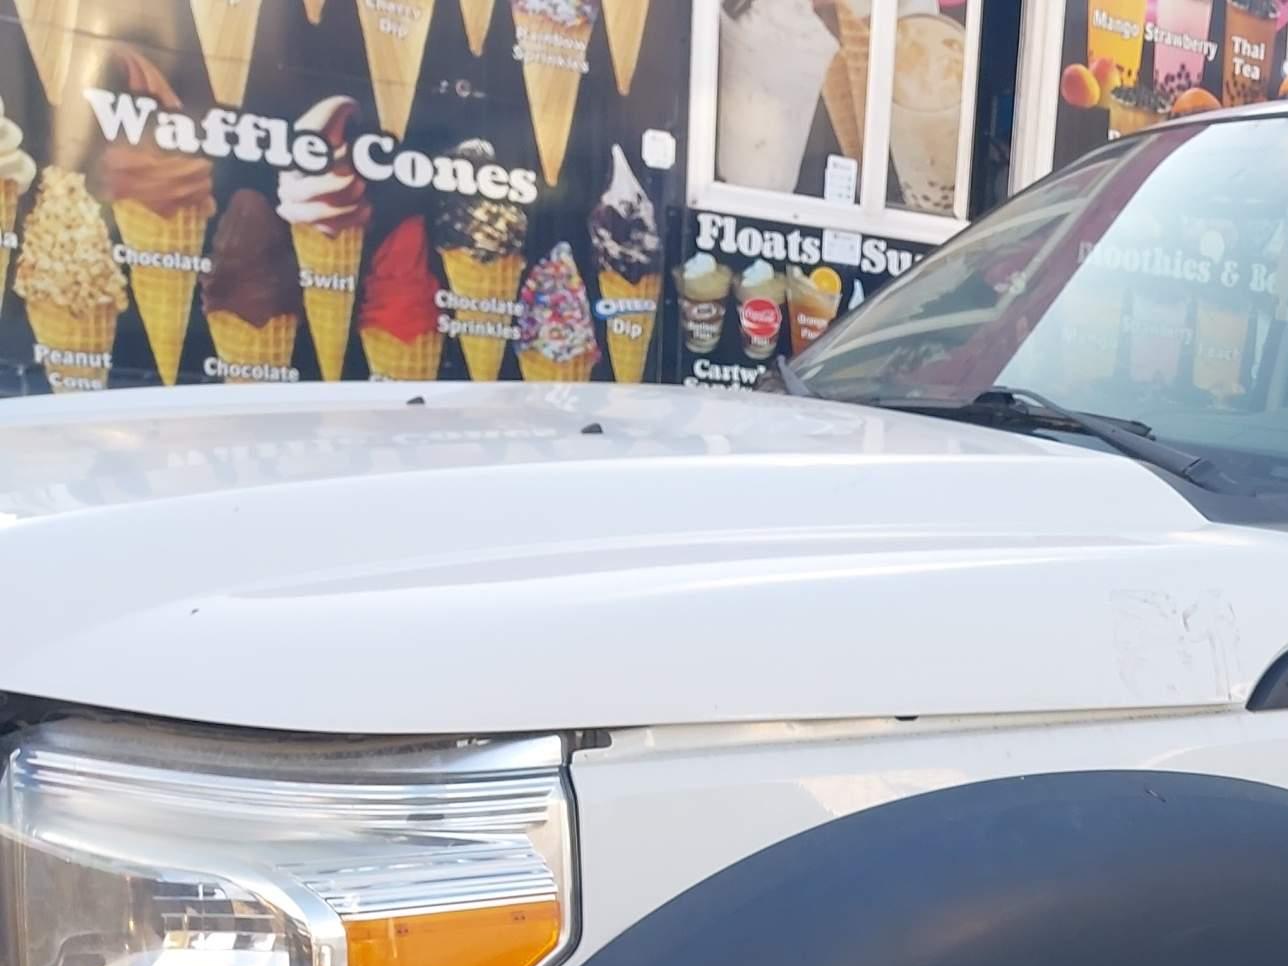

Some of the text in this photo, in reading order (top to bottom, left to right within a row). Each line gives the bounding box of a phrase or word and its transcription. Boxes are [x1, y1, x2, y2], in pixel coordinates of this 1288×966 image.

[1093, 9, 1140, 39] Mango
[1144, 22, 1218, 61] Strawberry
[1232, 36, 1266, 61] Thai
[1232, 57, 1261, 80] Tea
[82, 88, 538, 204] Waffle Cones
[697, 213, 821, 264] Floats
[861, 238, 923, 276] Su
[113, 244, 213, 273] Chocolate
[300, 269, 355, 292] Swirl
[435, 289, 525, 316] Chocolate
[438, 314, 522, 341] Sprinkles
[613, 318, 642, 340] Dip
[34, 344, 113, 369] Peanut
[204, 357, 300, 382] Chocolate
[693, 359, 766, 384] Cartw
